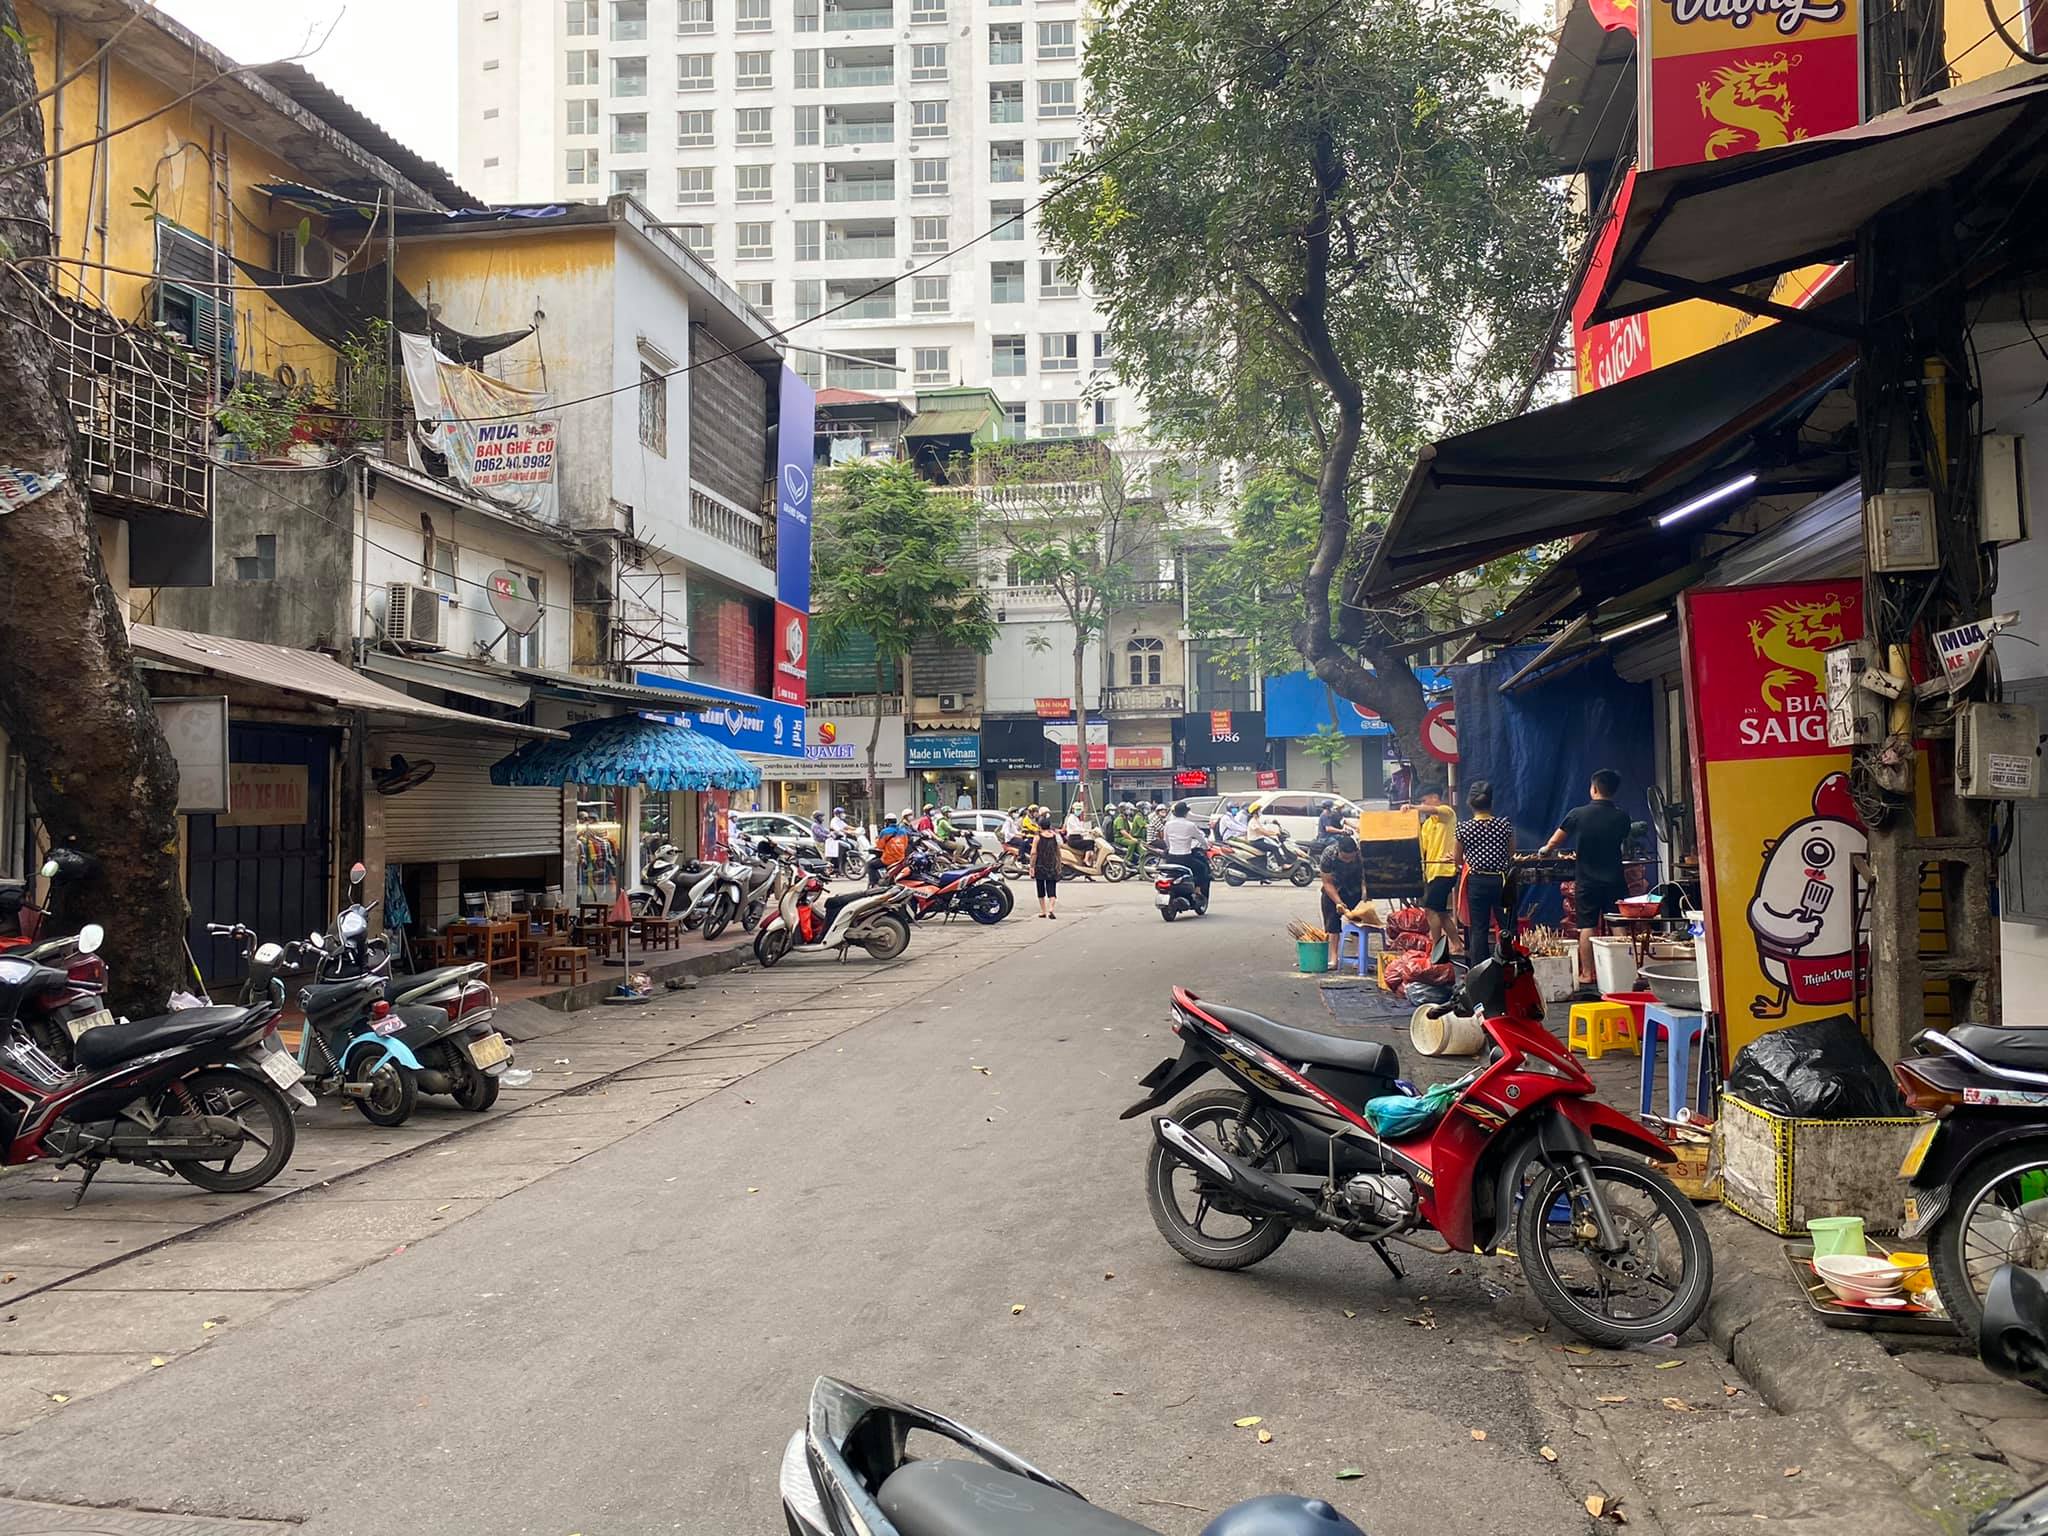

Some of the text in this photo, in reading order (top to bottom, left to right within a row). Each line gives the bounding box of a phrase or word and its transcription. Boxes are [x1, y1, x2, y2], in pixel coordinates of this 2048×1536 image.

[479, 424, 519, 442] MUA
[1938, 623, 1986, 653] MUA
[1946, 654, 1965, 671] XE
[1785, 695, 1828, 713] BIA
[1211, 732, 1240, 743] 1986
[1739, 715, 1825, 745] SAIG
[909, 747, 976, 759] Made in Vietnam
[1802, 970, 1831, 987] Thịnh
[1416, 1168, 1435, 1188] YAMA
